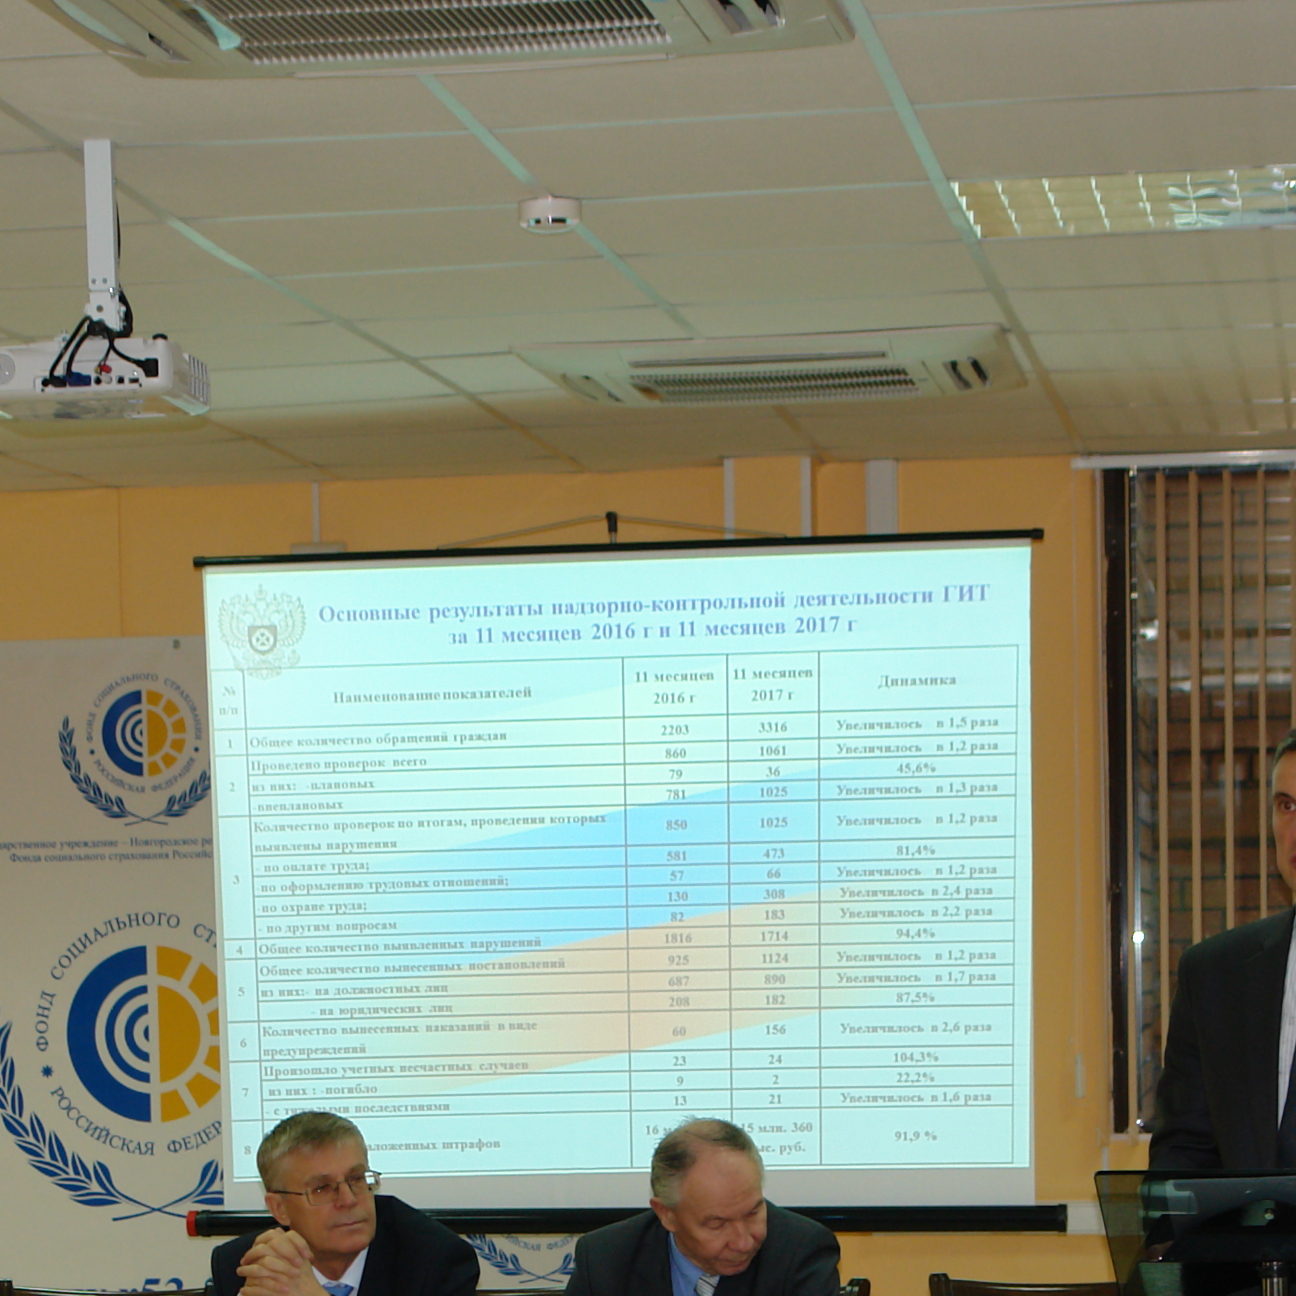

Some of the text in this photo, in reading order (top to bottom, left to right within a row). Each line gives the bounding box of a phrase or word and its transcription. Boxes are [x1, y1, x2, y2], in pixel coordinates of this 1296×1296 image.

[318, 584, 990, 623] Основные результаты надзорно-контрольной деятельности ГИТ
[448, 616, 857, 645] за 11 месяцев 2016 г и 11 месяцев 2017 г
[634, 671, 714, 684] 11 месяцев
[733, 668, 812, 681] 11 месяцев
[877, 675, 956, 690] Динамика
[333, 686, 532, 704] Наименование показателей
[653, 691, 696, 704] 2016 г
[751, 689, 794, 701] 2017 г
[660, 724, 689, 736] 2203
[758, 721, 787, 733] 3316
[836, 718, 922, 731] Увеличилось
[971, 718, 998, 729] раза
[250, 731, 507, 750] Общее количество обращений граждан
[665, 747, 686, 759] 860
[759, 745, 786, 756] 1061
[250, 756, 427, 774] Проведено проверок всего
[896, 762, 936, 774] 45,6%
[669, 768, 682, 779] 79
[766, 766, 780, 777] 36
[666, 788, 686, 799] 781
[759, 786, 787, 798] 1025
[253, 801, 343, 813] -внеплановых
[666, 819, 687, 831] 850
[759, 817, 787, 828] 1025
[59, 839, 118, 850] учреждение
[130, 837, 198, 849] Новгородское
[255, 839, 397, 854] выявлены нарушения
[10, 850, 212, 862] Фонда социального страхования Российс
[666, 850, 686, 862] 581
[763, 848, 784, 859] 473
[896, 845, 935, 857] 81,4%
[669, 871, 683, 882] 57
[766, 868, 780, 879] 66
[668, 890, 688, 902] 130
[763, 889, 784, 900] 308
[670, 911, 684, 922] 82
[764, 909, 784, 920] 183
[664, 932, 692, 944] 1816
[760, 930, 788, 942] 1714
[896, 927, 935, 940] 94,4%
[258, 937, 541, 956] Общее количество выявленных нарушений
[668, 954, 689, 965] 925
[761, 952, 788, 964] 1124
[260, 958, 565, 977] Общее количество вынесенных постановлений
[36, 912, 180, 1052] ФОНД СОЦИАЛЬНОГО
[668, 976, 689, 987] 687
[764, 974, 785, 985] 890
[668, 996, 689, 1007] 208
[765, 994, 785, 1005] 182
[896, 991, 934, 1003] 87,5%
[672, 1026, 686, 1038] 60
[765, 1024, 786, 1035] 156
[263, 1044, 366, 1059] предупреждений
[893, 1050, 938, 1063] 104,3%
[673, 1055, 686, 1066] 23
[768, 1053, 782, 1065] 24
[264, 1060, 528, 1078] Произошло учетных несчастных случаев
[676, 1075, 683, 1086] 9
[772, 1073, 779, 1084] 2
[896, 1071, 934, 1083] 22,2%
[673, 1095, 687, 1106] 13
[768, 1093, 782, 1105] 21
[50, 1086, 221, 1155] РОССИЙСКАЯ ФЕДЕР
[757, 1121, 812, 1133] млн. 360
[894, 1130, 937, 1142] 91,9 %
[780, 1140, 805, 1155] руб.
